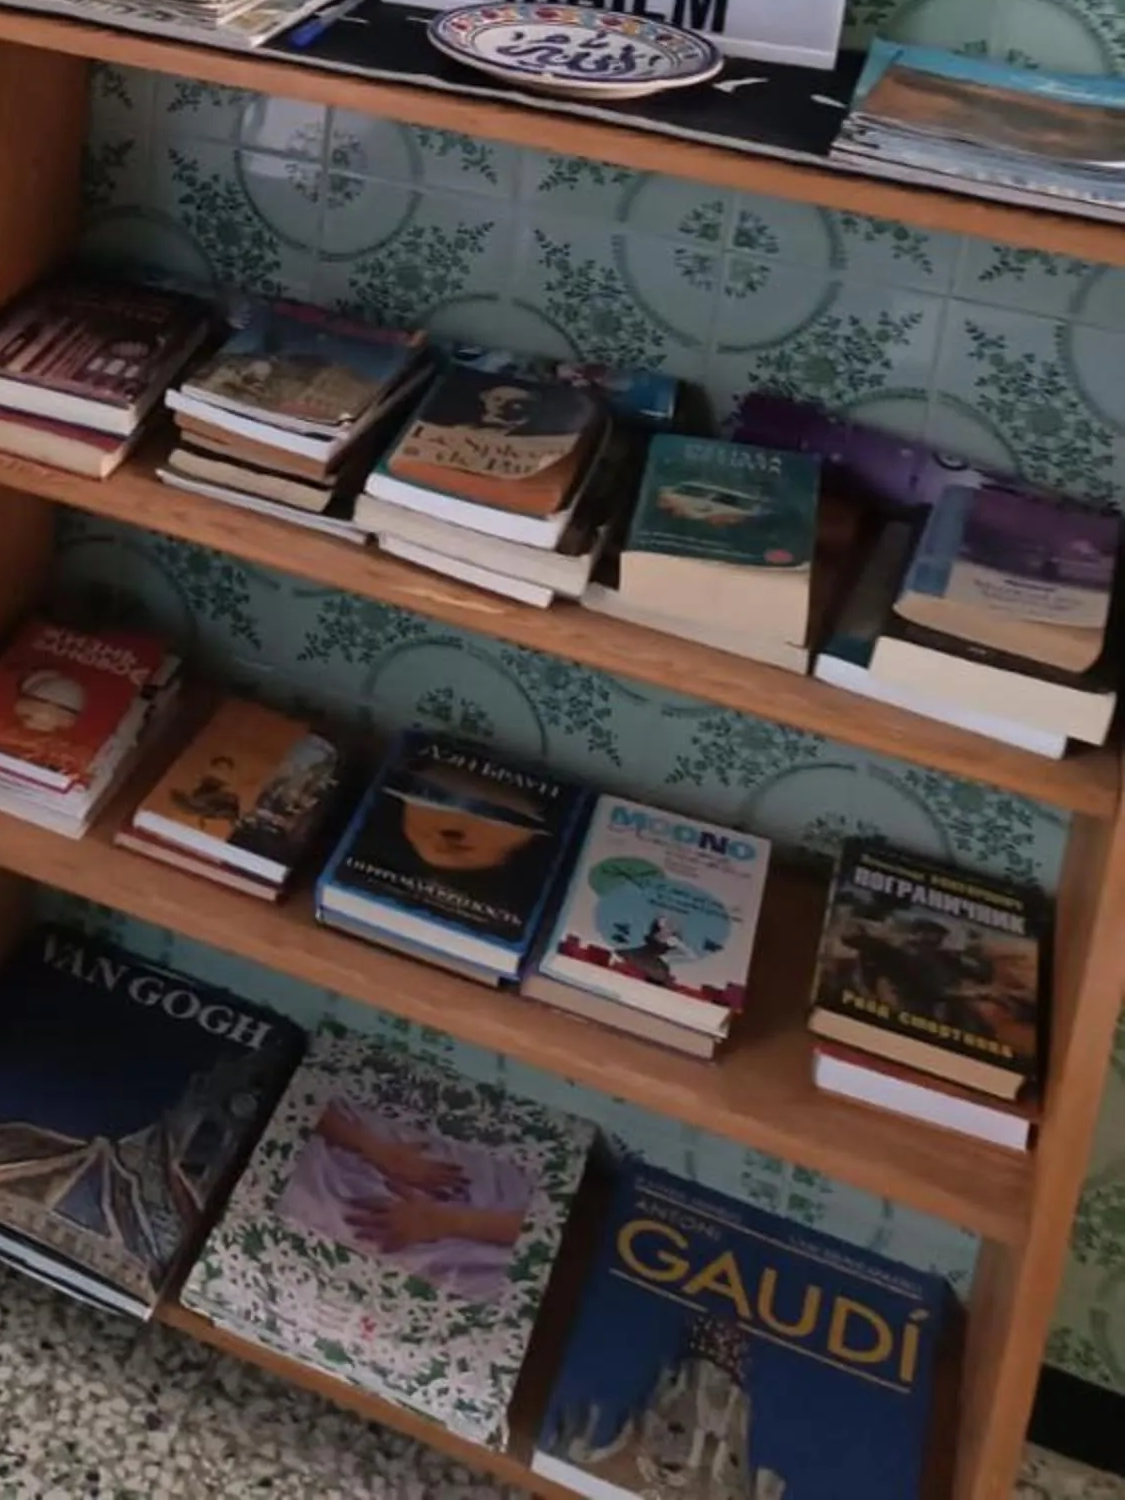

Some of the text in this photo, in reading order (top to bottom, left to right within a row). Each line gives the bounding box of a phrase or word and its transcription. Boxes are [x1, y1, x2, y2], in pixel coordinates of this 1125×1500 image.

[854, 867, 1025, 935] ПОГРАНИЧНИК
[42, 933, 273, 1051] VAN GOGH
[616, 1218, 930, 1384] GAUDÍ
